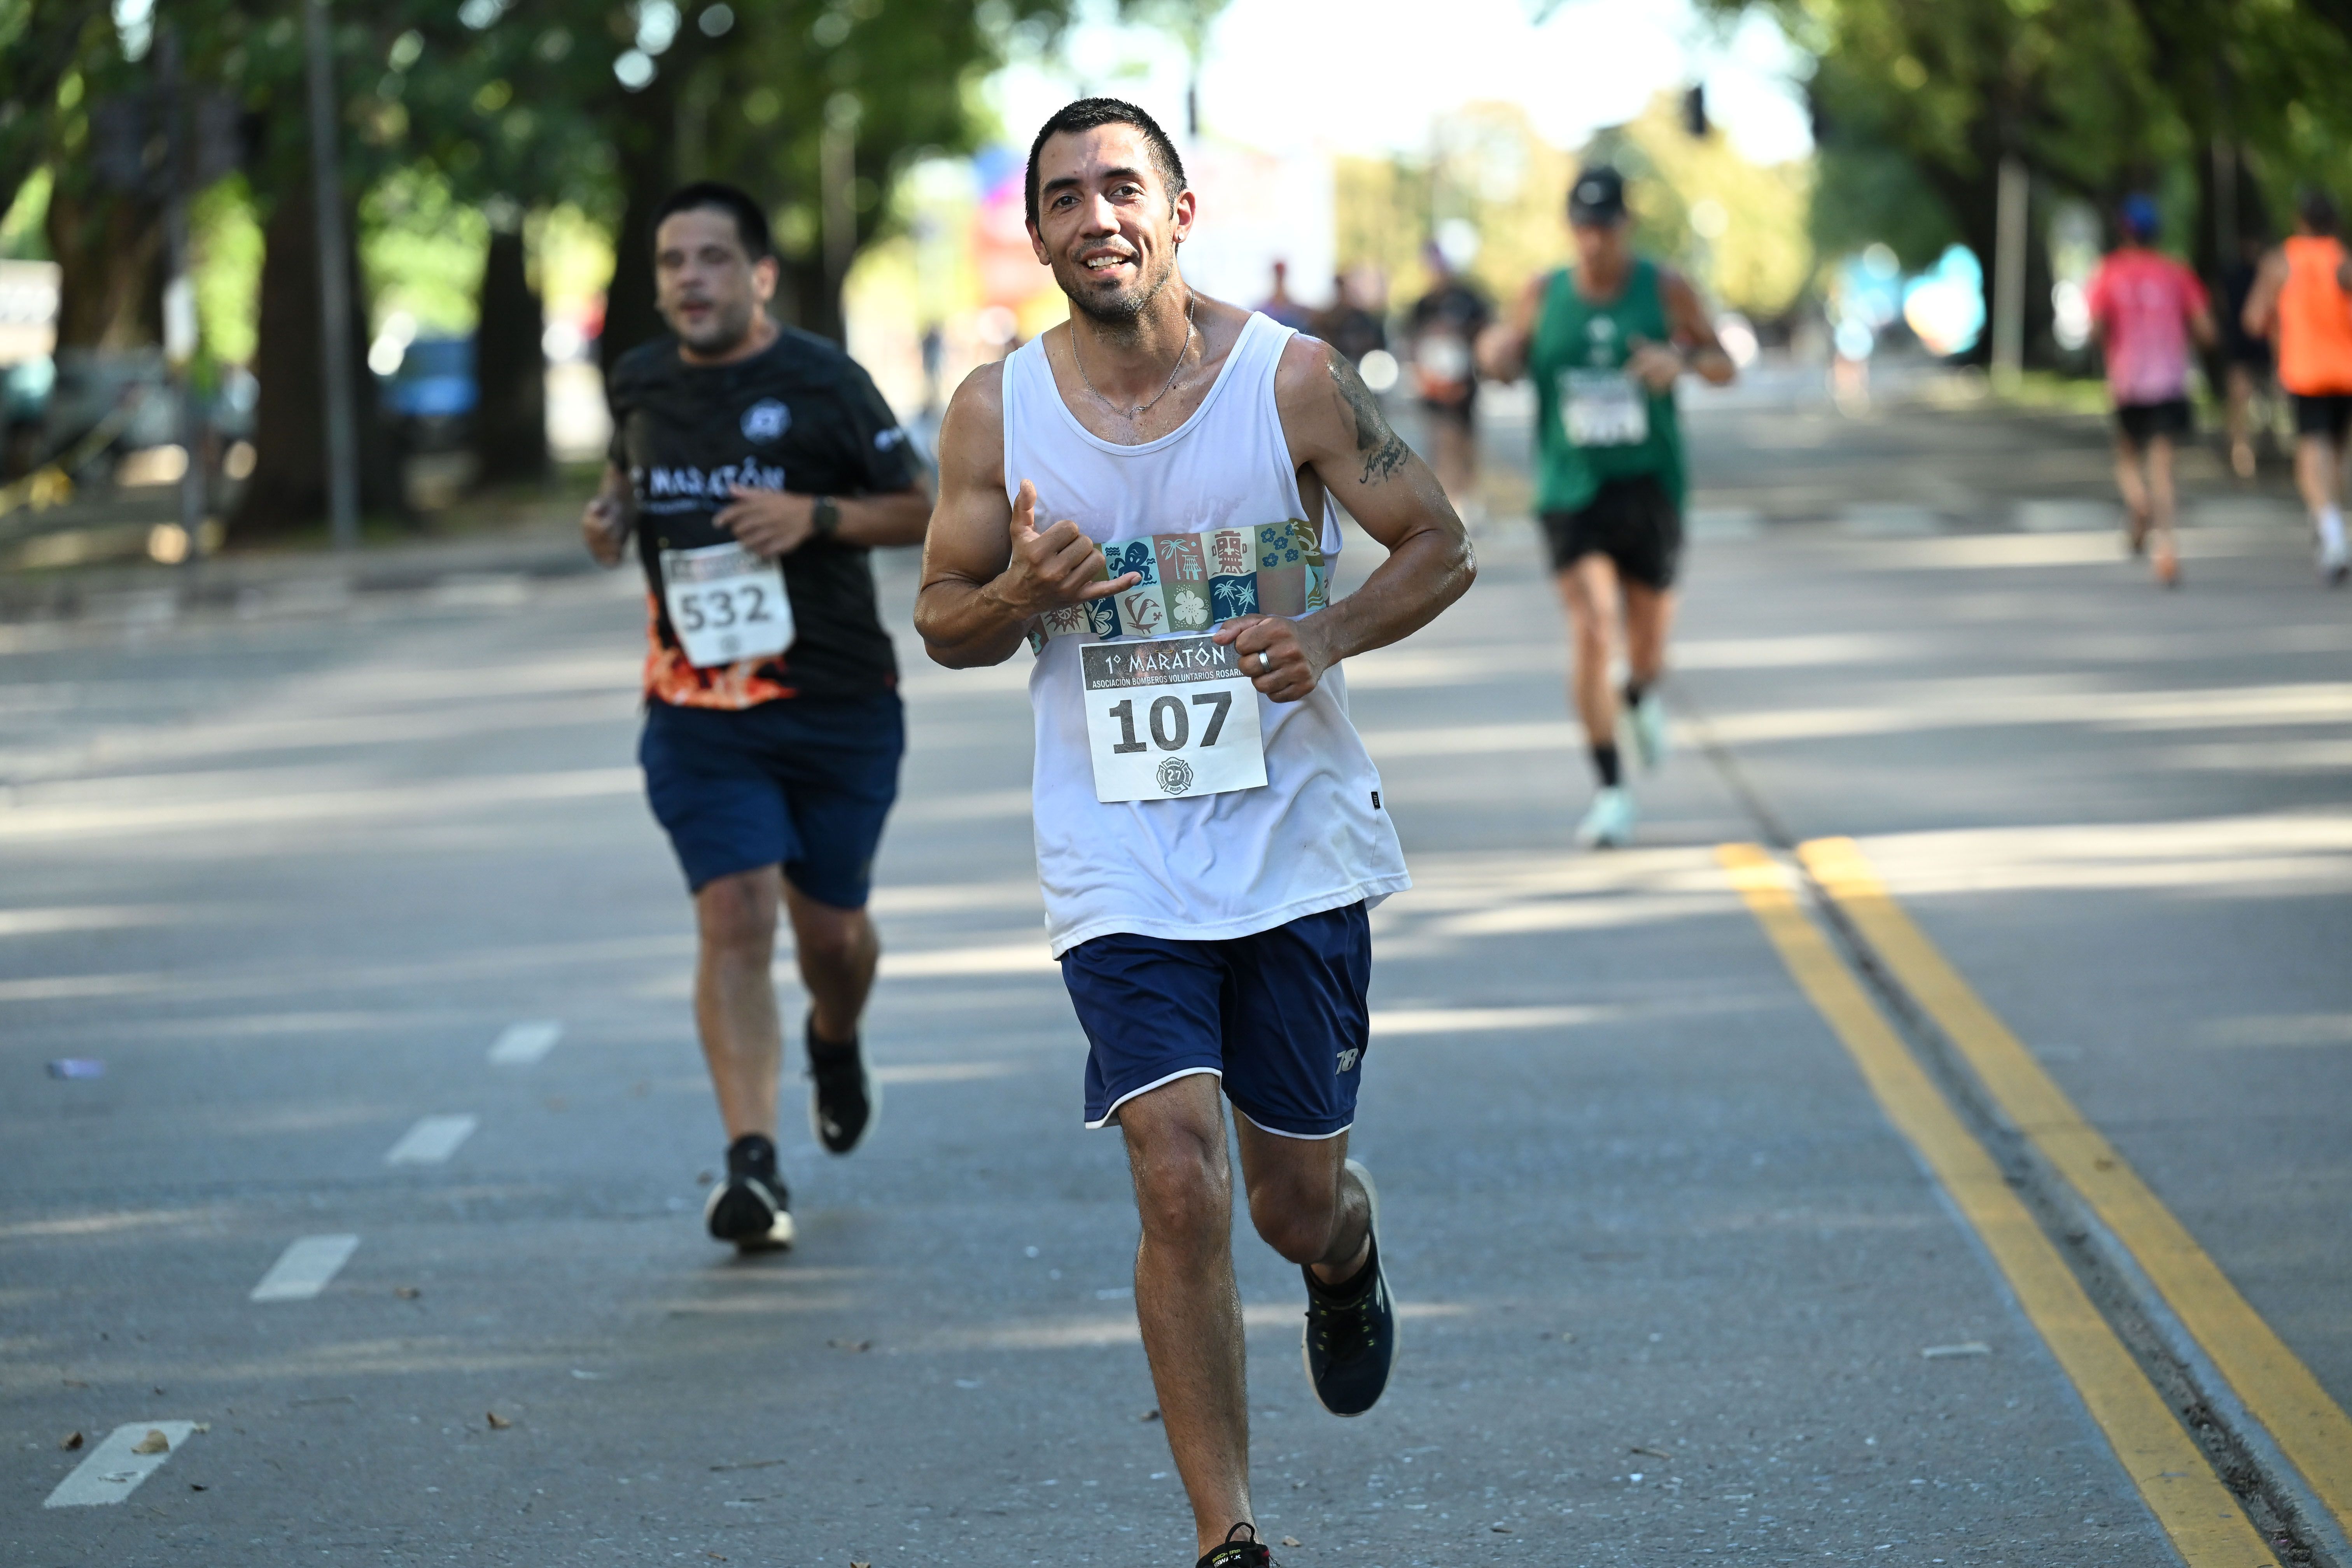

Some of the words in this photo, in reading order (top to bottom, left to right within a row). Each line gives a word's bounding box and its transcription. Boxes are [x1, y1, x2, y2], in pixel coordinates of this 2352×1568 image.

[681, 584, 773, 632] 532
[1129, 641, 1225, 672] MARATÓN
[1092, 677, 1130, 688] ASOCIACIÓN
[1132, 675, 1167, 686] BOMBEROS
[1169, 672, 1214, 683] VOLUNTARIOS
[1216, 668, 1244, 679] ROSARI
[1109, 691, 1232, 754] 107
[1167, 769, 1181, 782] 27
[1336, 1048, 1358, 1075] 78
